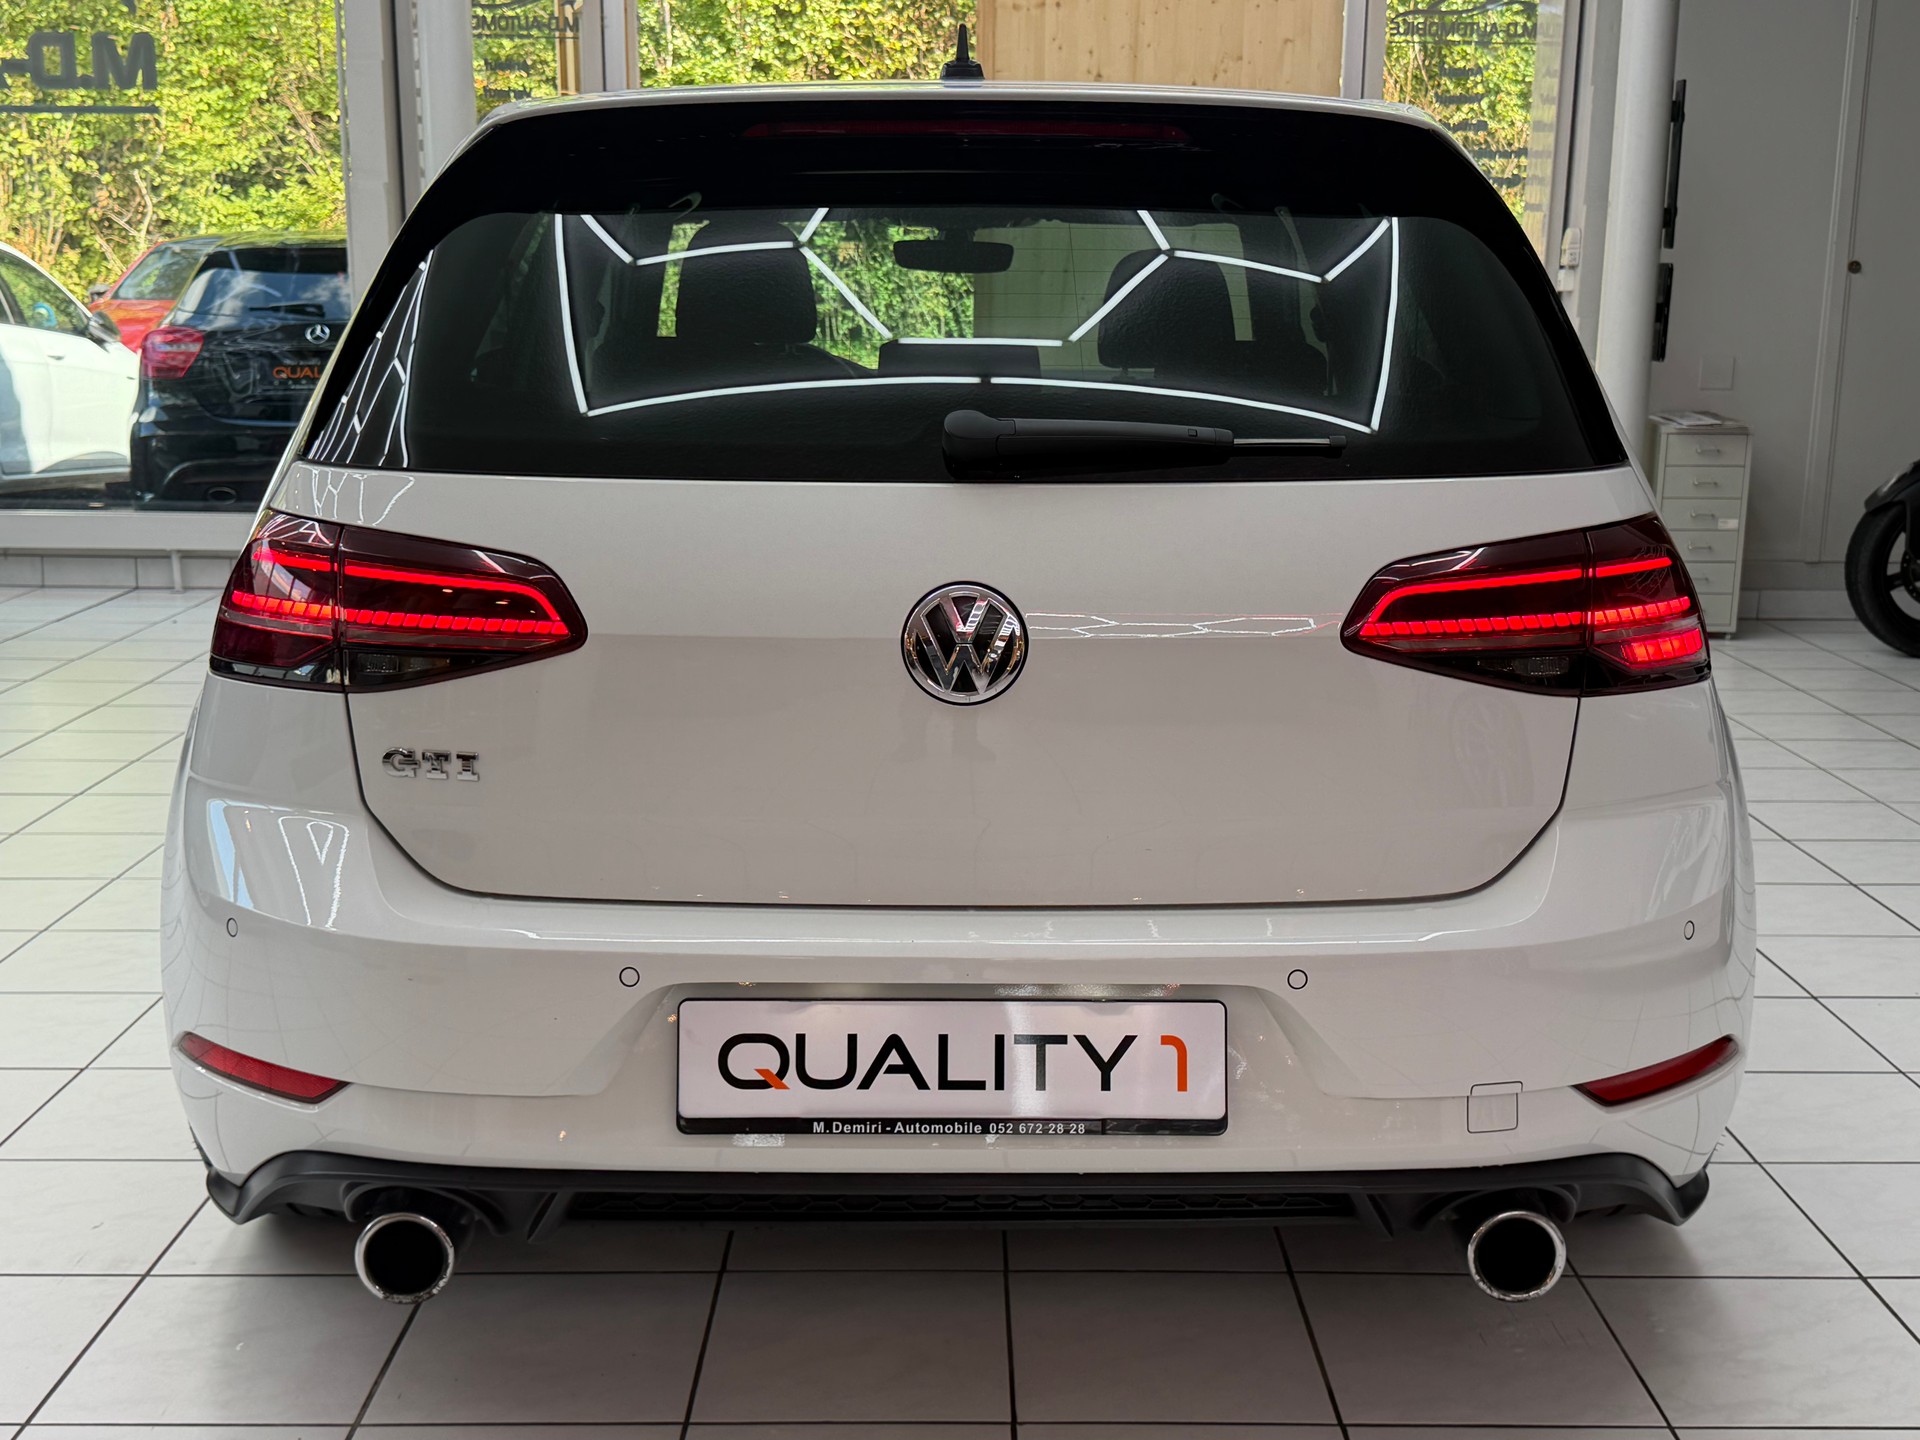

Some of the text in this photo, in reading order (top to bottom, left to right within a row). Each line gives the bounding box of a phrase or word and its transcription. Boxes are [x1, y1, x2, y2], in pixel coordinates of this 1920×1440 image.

[382, 747, 480, 782] GTI
[718, 1033, 1188, 1092] QUALITY 1
[989, 1122, 1014, 1134] 052
[1018, 1122, 1043, 1134] 672
[1048, 1122, 1064, 1134] 28
[1069, 1122, 1085, 1134] 28
